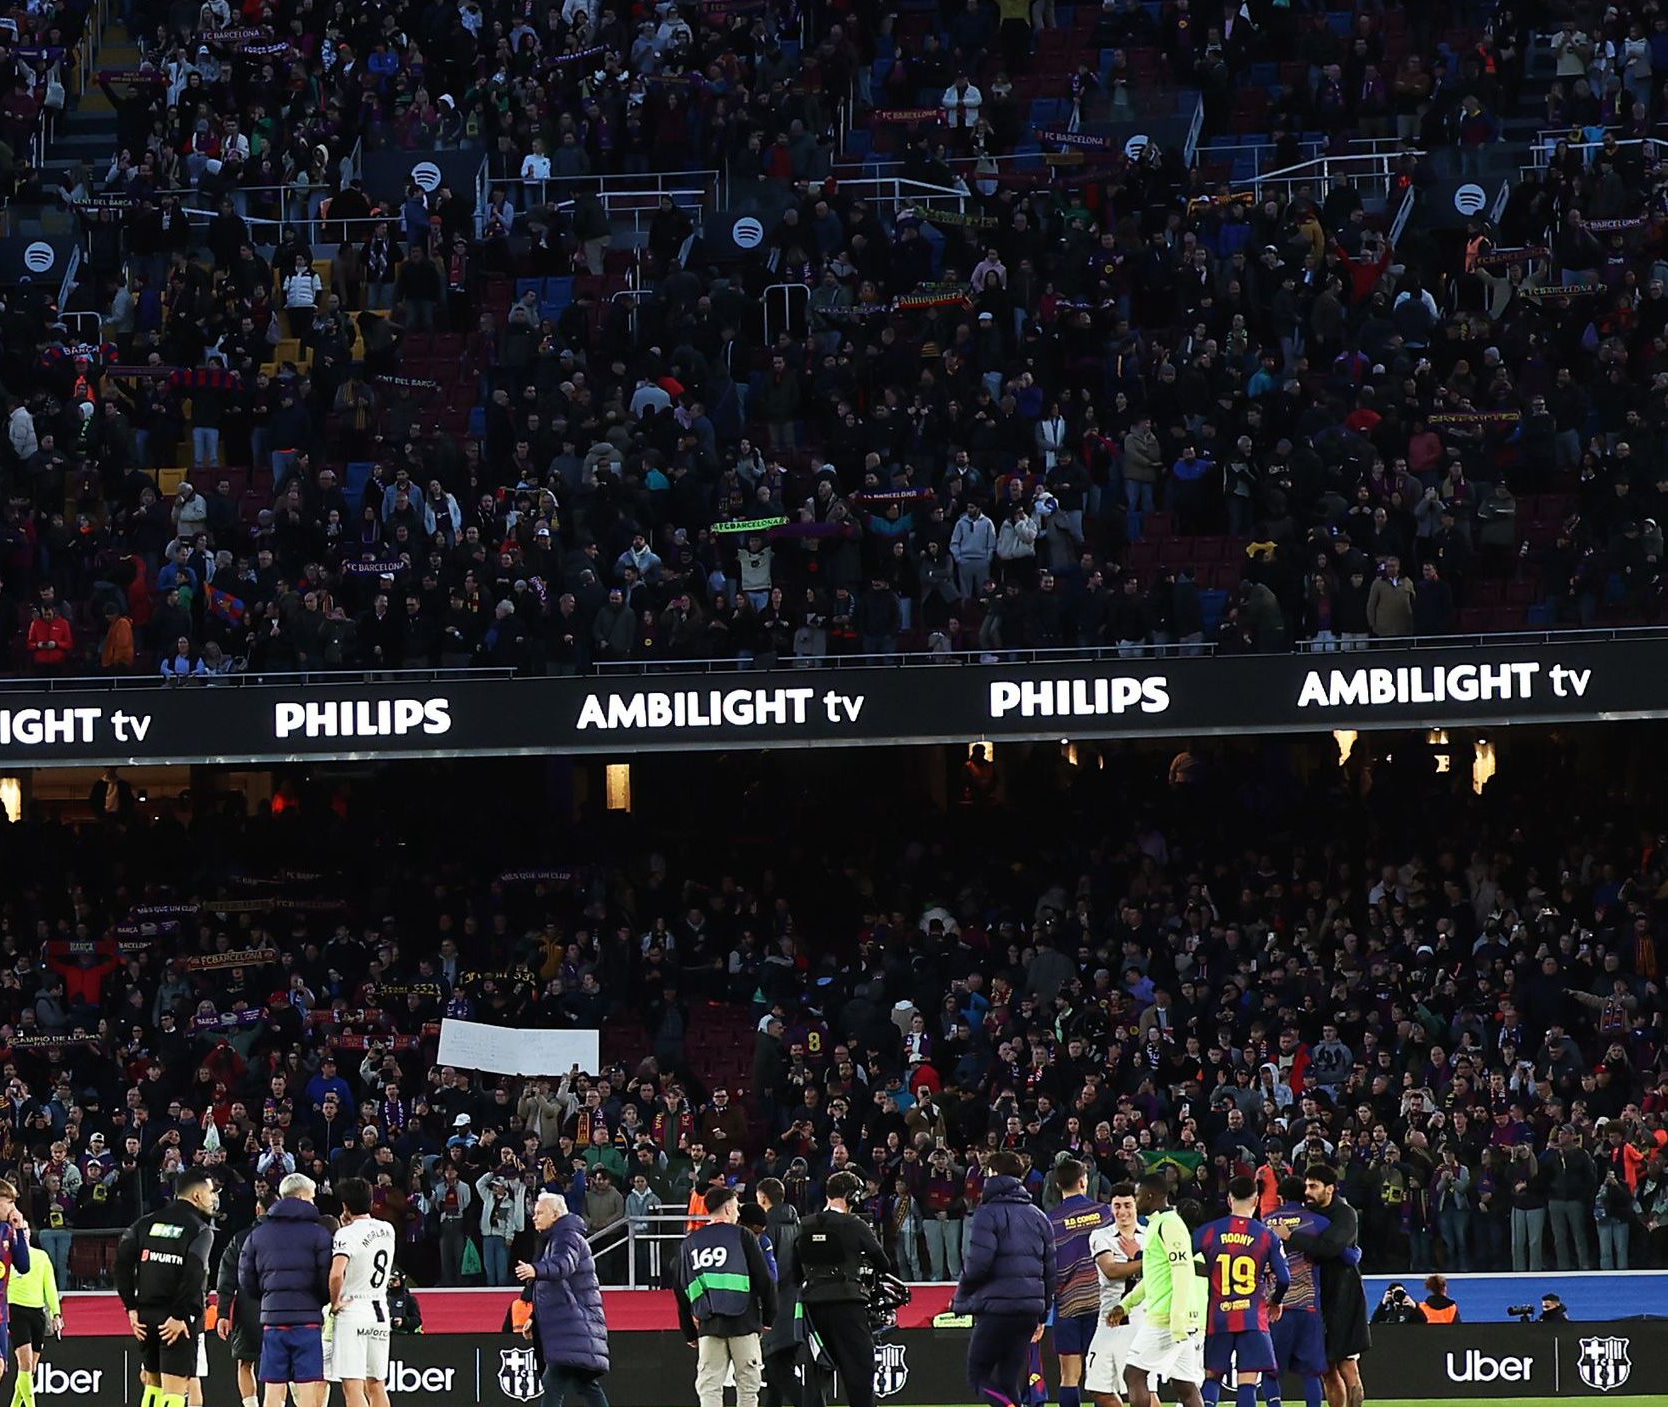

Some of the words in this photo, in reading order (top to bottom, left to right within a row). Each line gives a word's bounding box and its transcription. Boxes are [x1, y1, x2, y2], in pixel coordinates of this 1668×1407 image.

[203, 32, 212, 40] FC
[213, 30, 260, 41] BARCELONA
[1044, 132, 1055, 140] FC
[1056, 133, 1103, 146] BARCELONA
[347, 562, 356, 571] FC
[357, 563, 404, 573] BARCELONA
[991, 677, 1170, 718] PHILIPS
[1298, 663, 1540, 707] AMBILIGHT
[1549, 664, 1592, 697] tv
[276, 699, 452, 738] PHILIPS
[577, 689, 814, 730] AMBILIGHT
[823, 691, 865, 723] tv
[111, 710, 151, 742] tv
[70, 943, 95, 953] BARÇA
[808, 1031, 821, 1053] 8
[1219, 1233, 1255, 1246] ROONY
[370, 1249, 388, 1288] 8
[690, 1247, 727, 1271] 169
[1169, 1251, 1188, 1262] OK
[1215, 1253, 1258, 1295] 19
[1446, 1349, 1533, 1382] Uber
